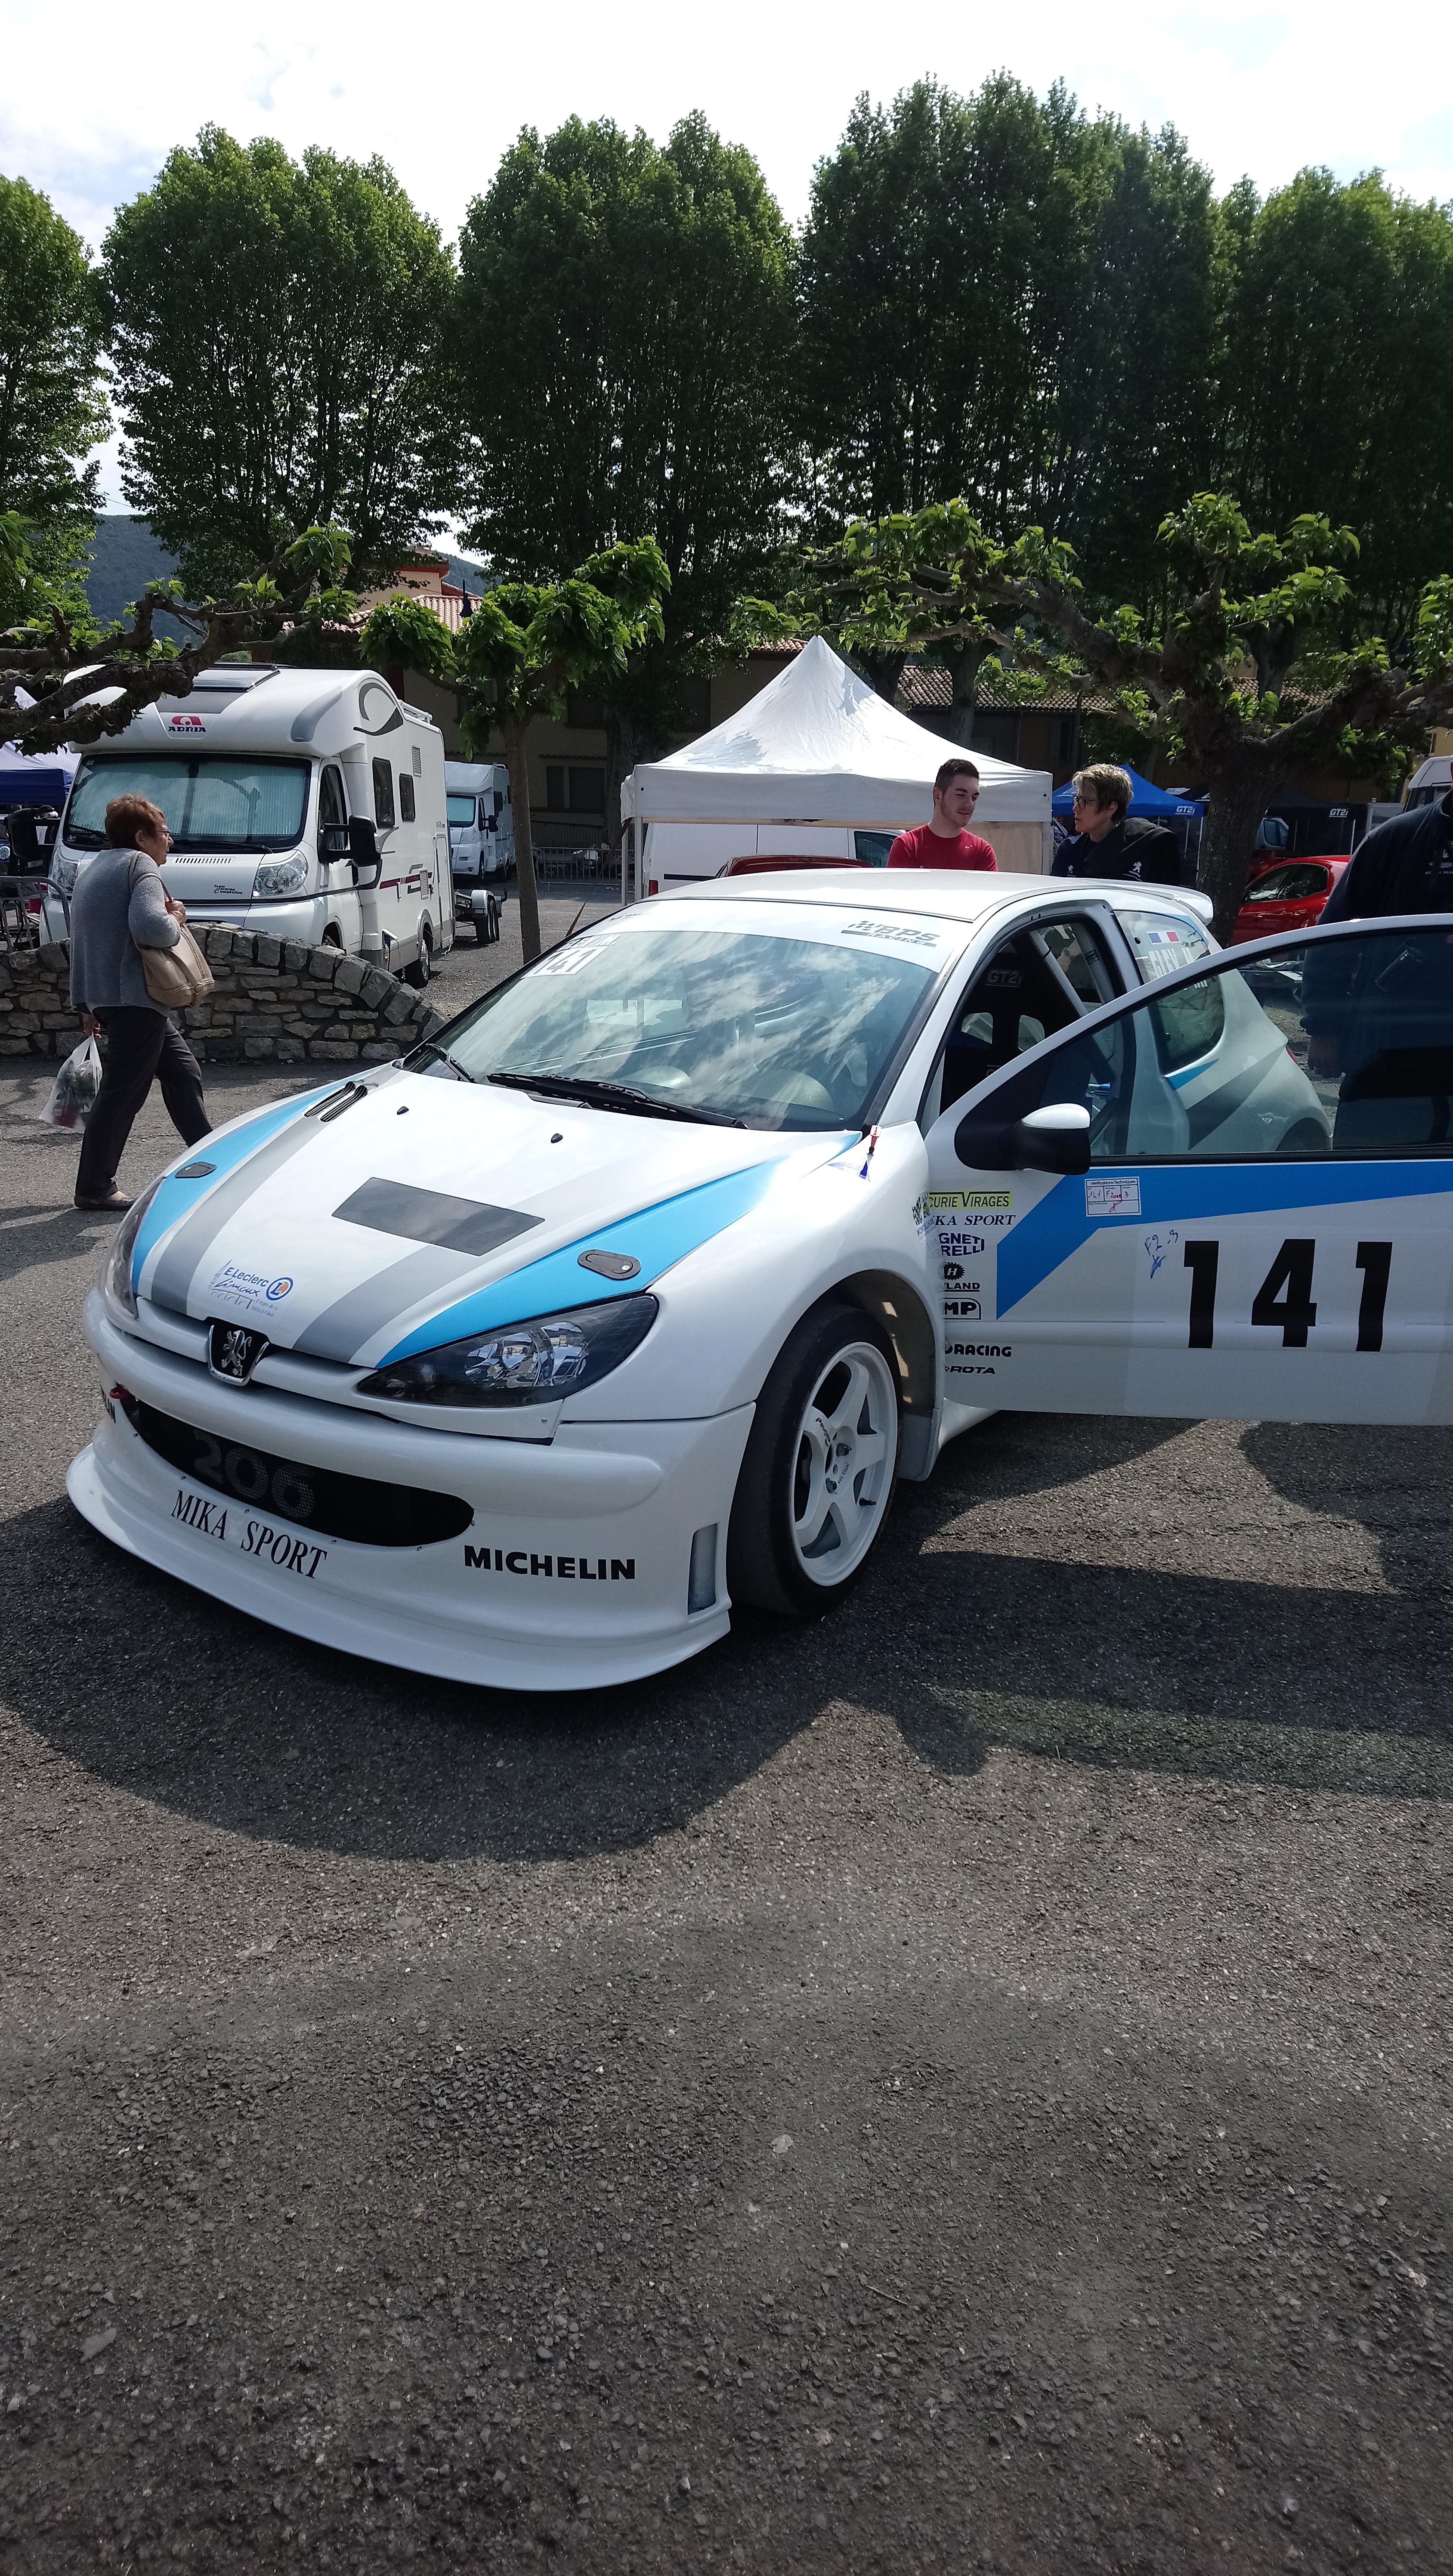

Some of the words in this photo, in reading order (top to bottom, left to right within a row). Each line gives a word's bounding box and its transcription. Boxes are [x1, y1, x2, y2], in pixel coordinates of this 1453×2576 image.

[867, 933, 927, 945] RACING
[533, 948, 597, 975] 141
[929, 1197, 958, 1208] CURIE
[962, 1192, 1010, 1207] VIRAGES
[934, 1215, 958, 1226] KA
[965, 1215, 1016, 1226] SPORT
[938, 1232, 985, 1247] GNETI
[214, 1278, 261, 1297] Limoux
[1184, 1238, 1393, 1353] 141
[945, 1302, 977, 1315] MP
[945, 1344, 1012, 1357] RACING
[194, 1429, 315, 1518] 206
[170, 1489, 226, 1540] MIKA
[240, 1521, 328, 1579] SPORT
[464, 1545, 635, 1580] MICHELIN
